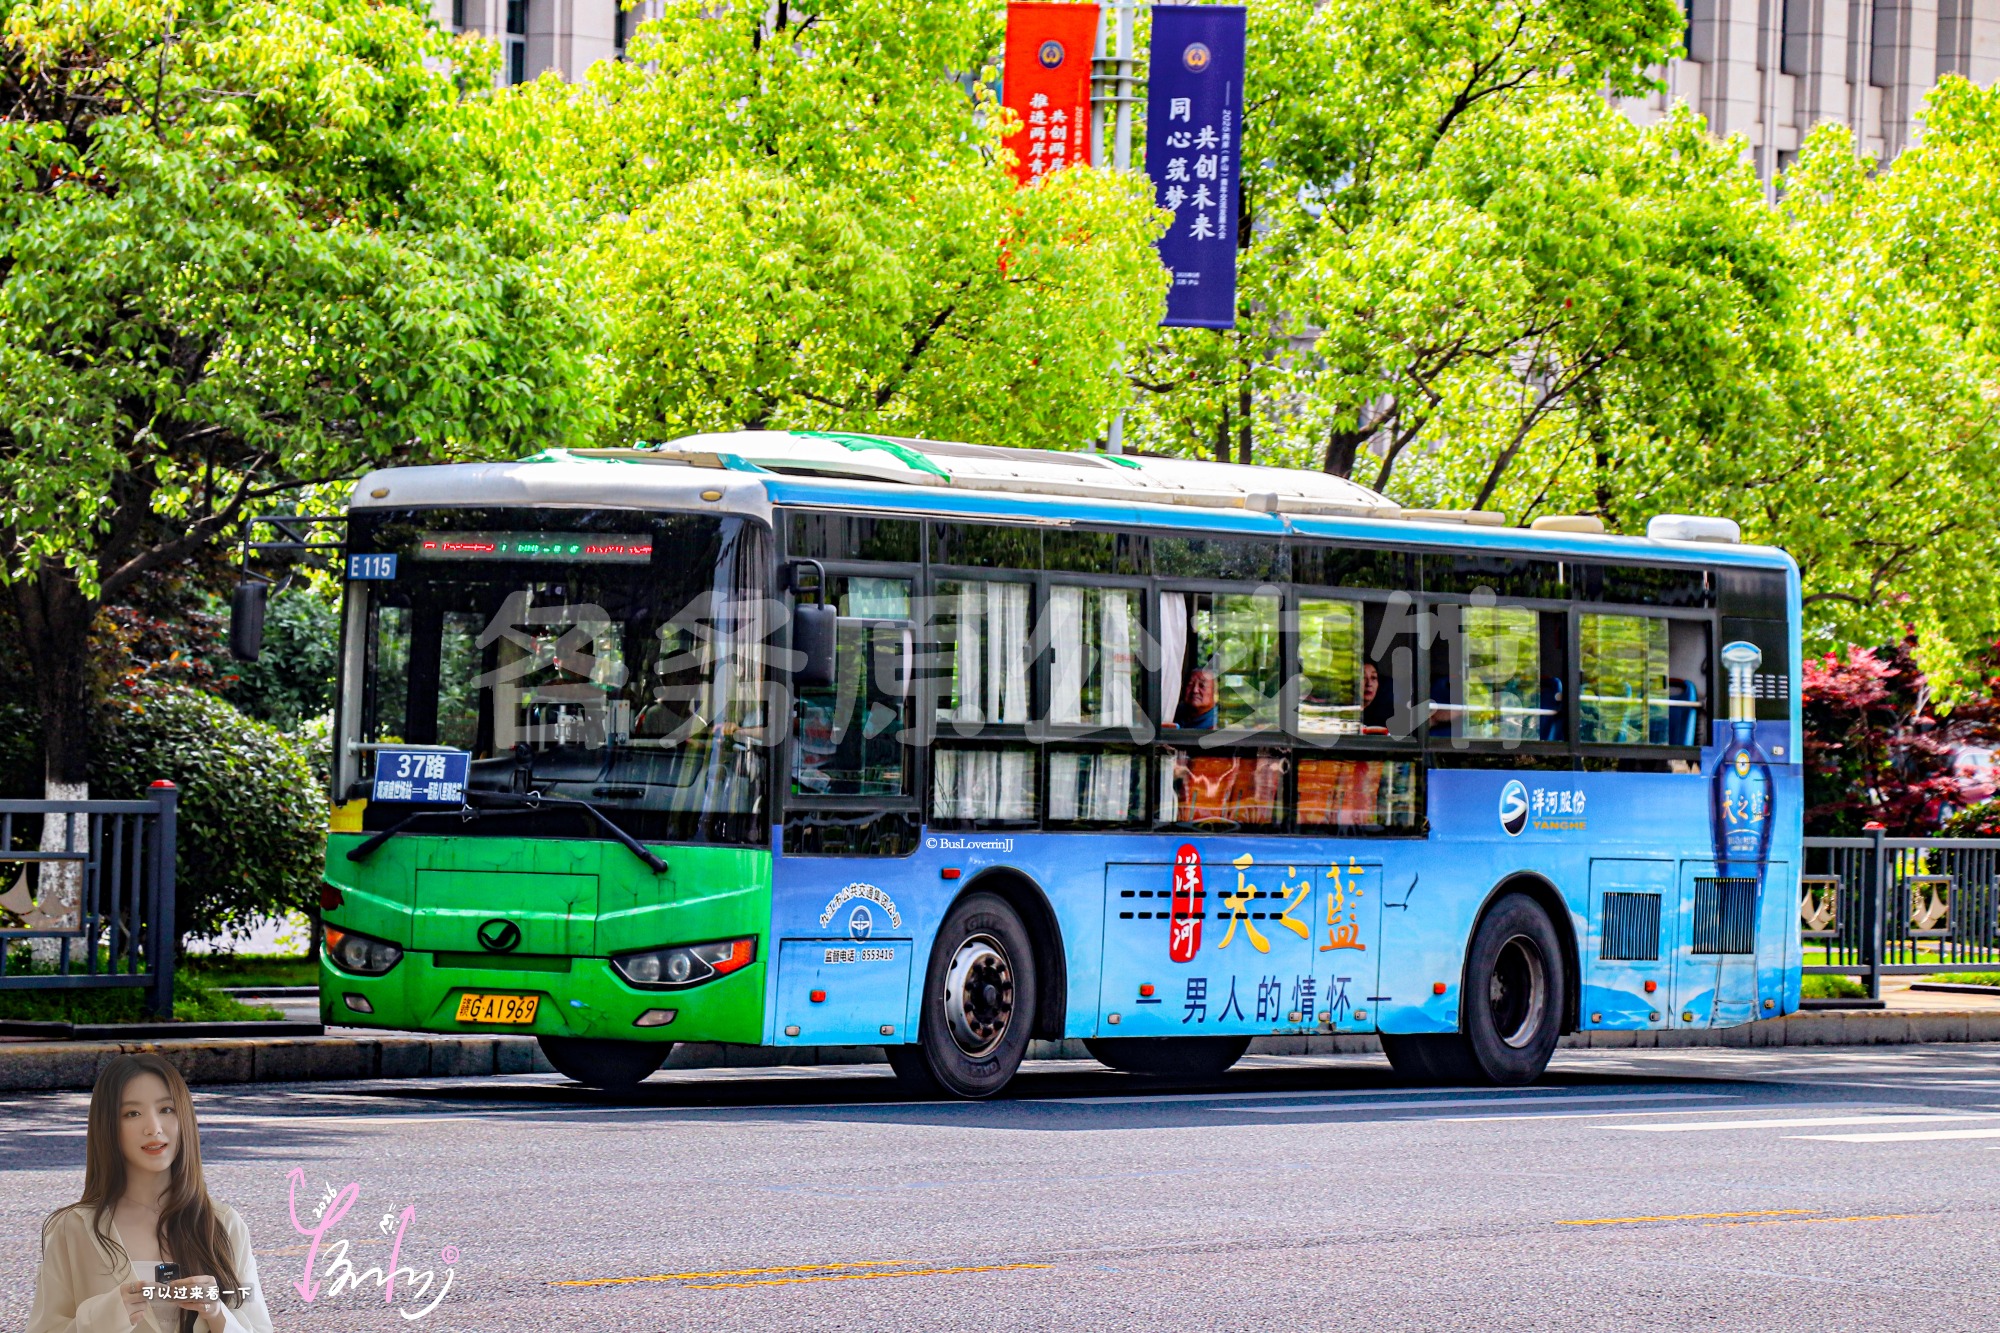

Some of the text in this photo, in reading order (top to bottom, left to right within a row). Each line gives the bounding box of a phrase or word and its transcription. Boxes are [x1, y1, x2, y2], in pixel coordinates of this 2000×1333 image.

[1164, 97, 1192, 211] 同心筑梦
[1189, 124, 1220, 241] 共创未来
[396, 754, 446, 779] 37路
[1532, 788, 1586, 817] 洋河股份
[1533, 821, 1587, 831] YANGHE
[1174, 853, 1200, 958] 洋河
[1182, 975, 1352, 1024] 男人的情怀
